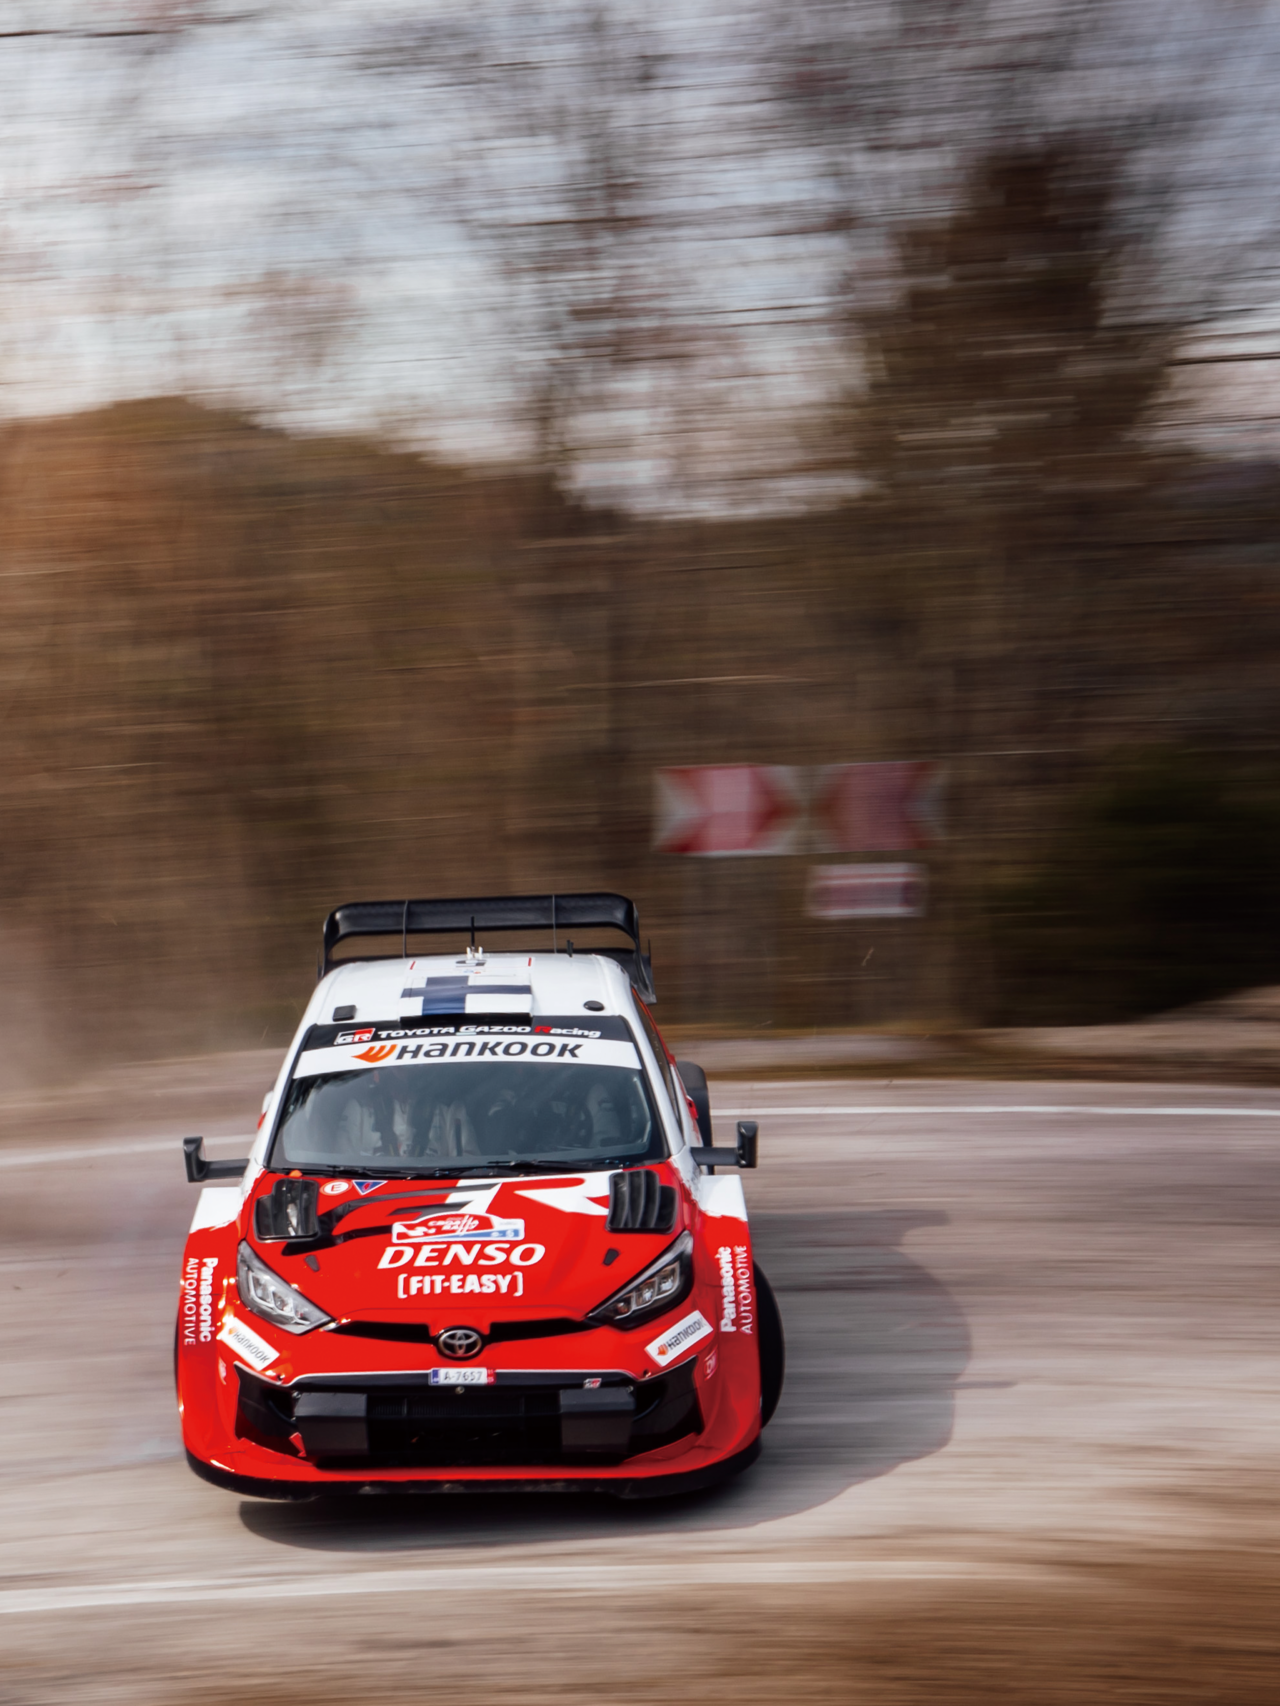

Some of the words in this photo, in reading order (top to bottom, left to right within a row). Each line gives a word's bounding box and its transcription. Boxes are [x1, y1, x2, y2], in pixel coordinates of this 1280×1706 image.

[337, 1031, 372, 1043] GR
[377, 1026, 456, 1038] TOYOTA
[457, 1025, 531, 1035] GAZOO
[534, 1025, 602, 1038] Racing
[331, 1182, 342, 1192] E
[376, 1243, 546, 1270] DENSO
[715, 1246, 737, 1332] Panasonic
[733, 1245, 752, 1335] AUTOMOTIVE
[184, 1258, 199, 1345] AUTOMOTIVE
[199, 1258, 218, 1342] Panasonic
